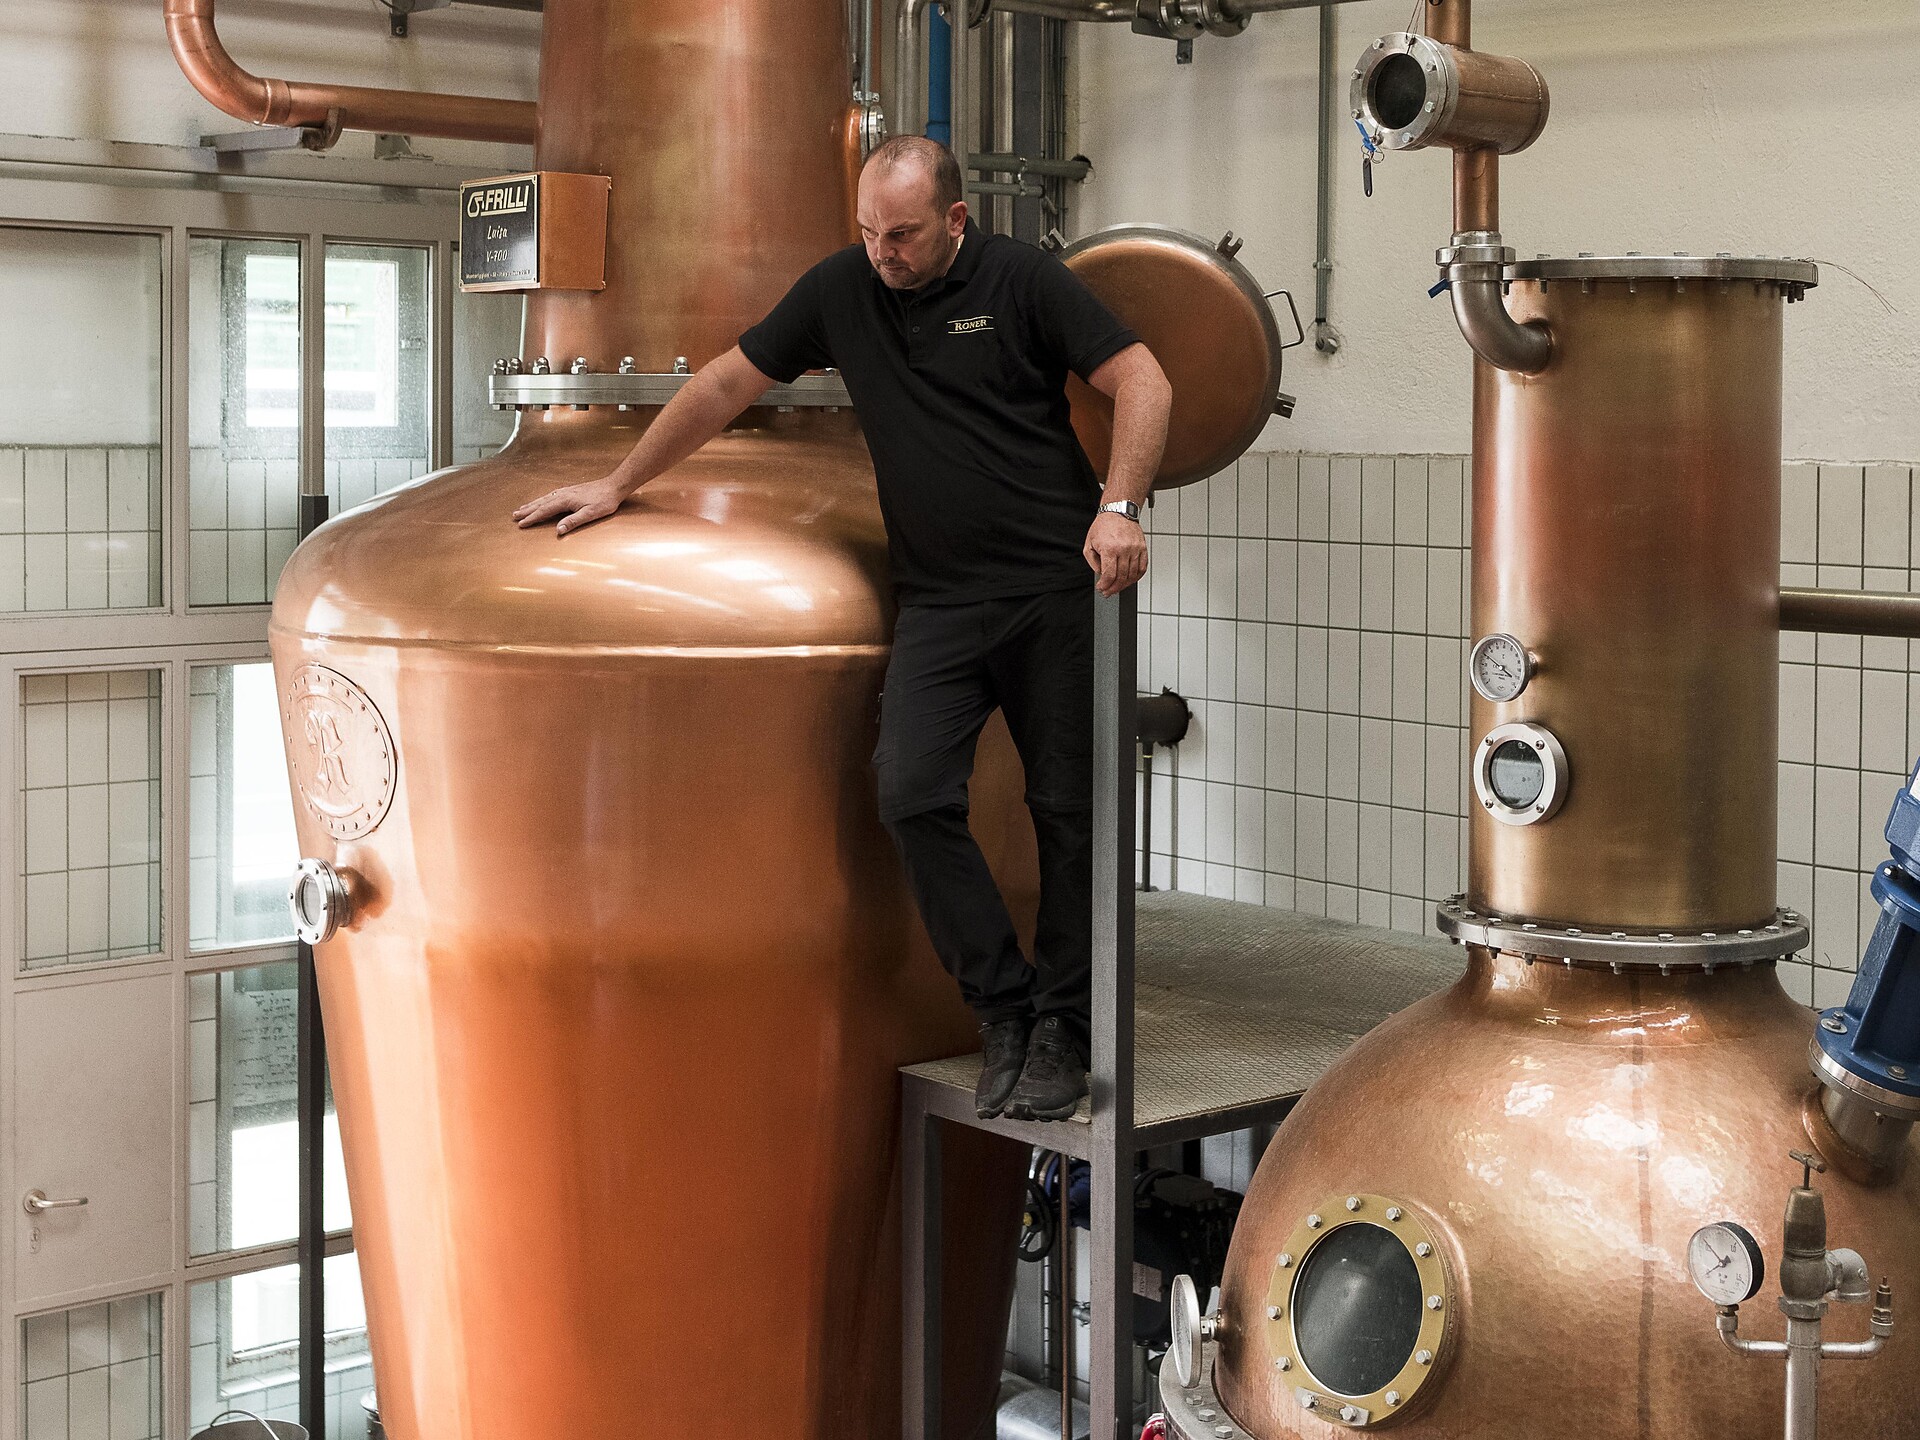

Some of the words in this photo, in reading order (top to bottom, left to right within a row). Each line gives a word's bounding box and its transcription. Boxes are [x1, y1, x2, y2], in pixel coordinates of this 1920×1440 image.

[487, 225, 508, 240] Luisa
[486, 249, 508, 263] V-700
[954, 319, 987, 331] RONER
